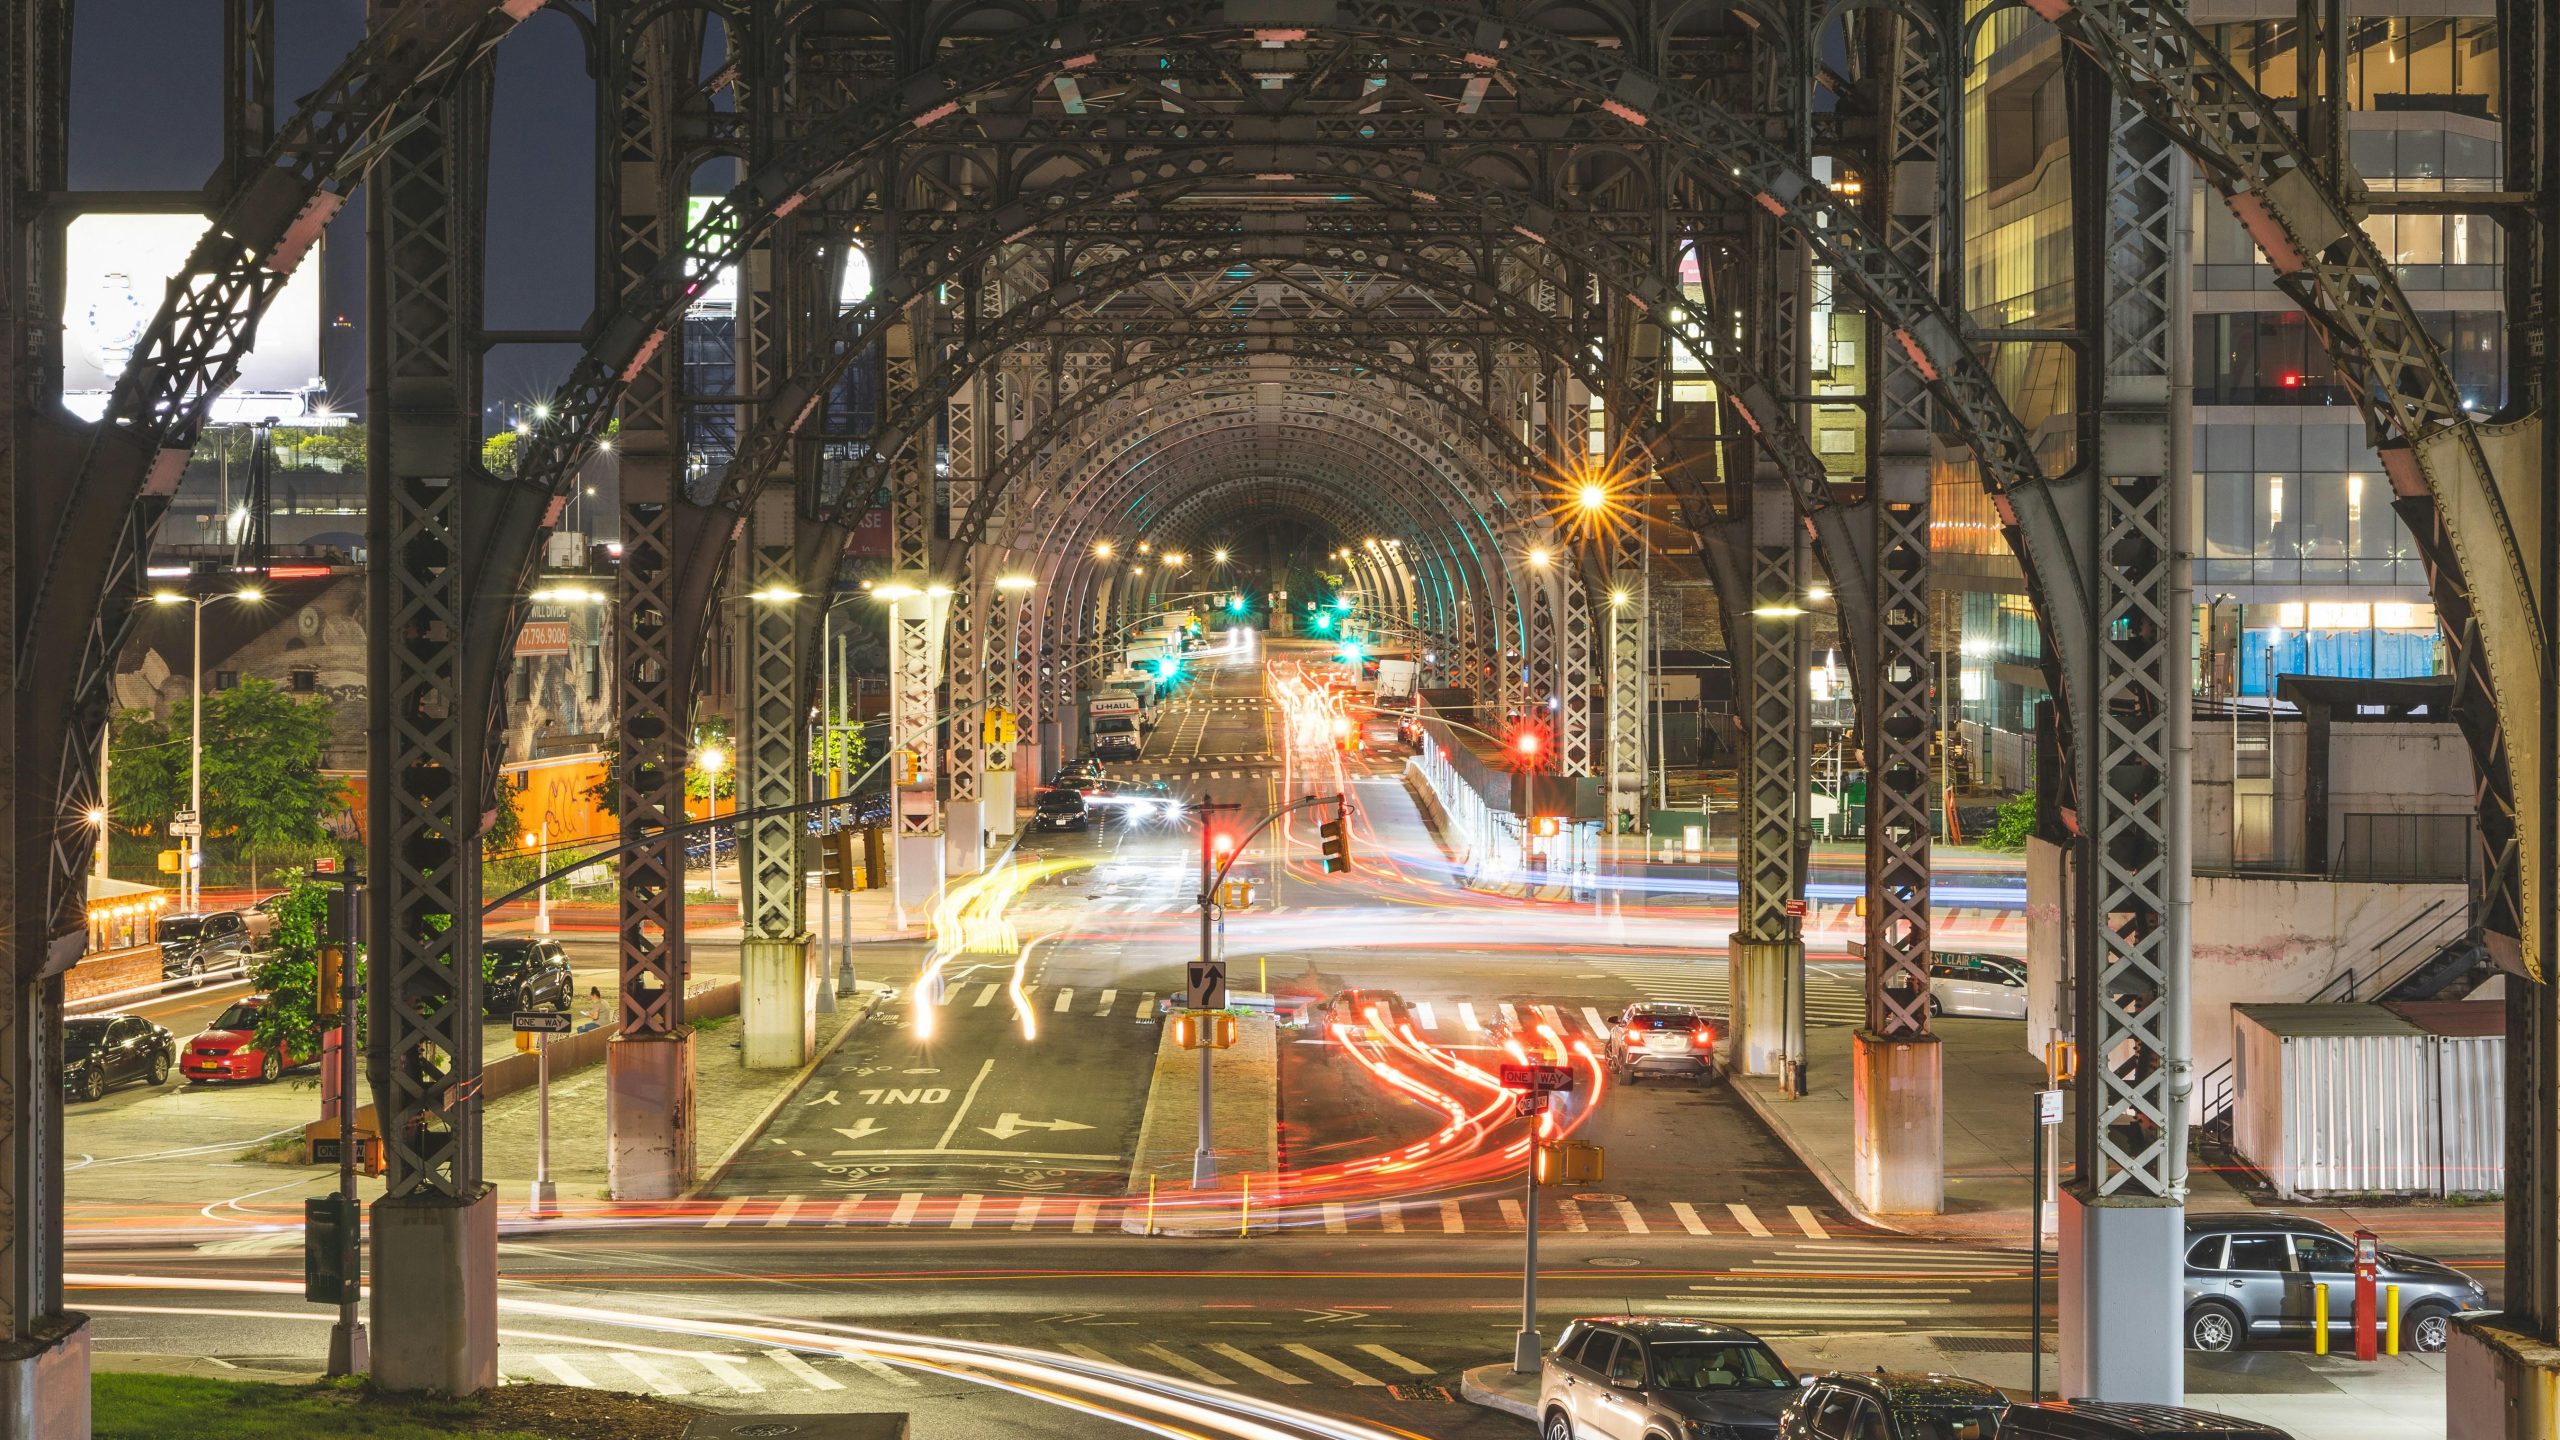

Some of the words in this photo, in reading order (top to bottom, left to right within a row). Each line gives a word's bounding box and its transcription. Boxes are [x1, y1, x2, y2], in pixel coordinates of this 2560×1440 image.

[531, 606, 546, 618] WILL
[547, 605, 566, 618] DIVIDE
[516, 628, 566, 646] 17.796.9006
[1096, 702, 1131, 711] U-HAUL
[1934, 952, 1943, 965] ST
[1947, 954, 1969, 967] CLAIR
[518, 1018, 536, 1026] ONE
[544, 1018, 563, 1027] WAY
[1506, 1071, 1529, 1082] ONE
[1540, 1073, 1564, 1084] WAY
[804, 1088, 951, 1106] ONLY
